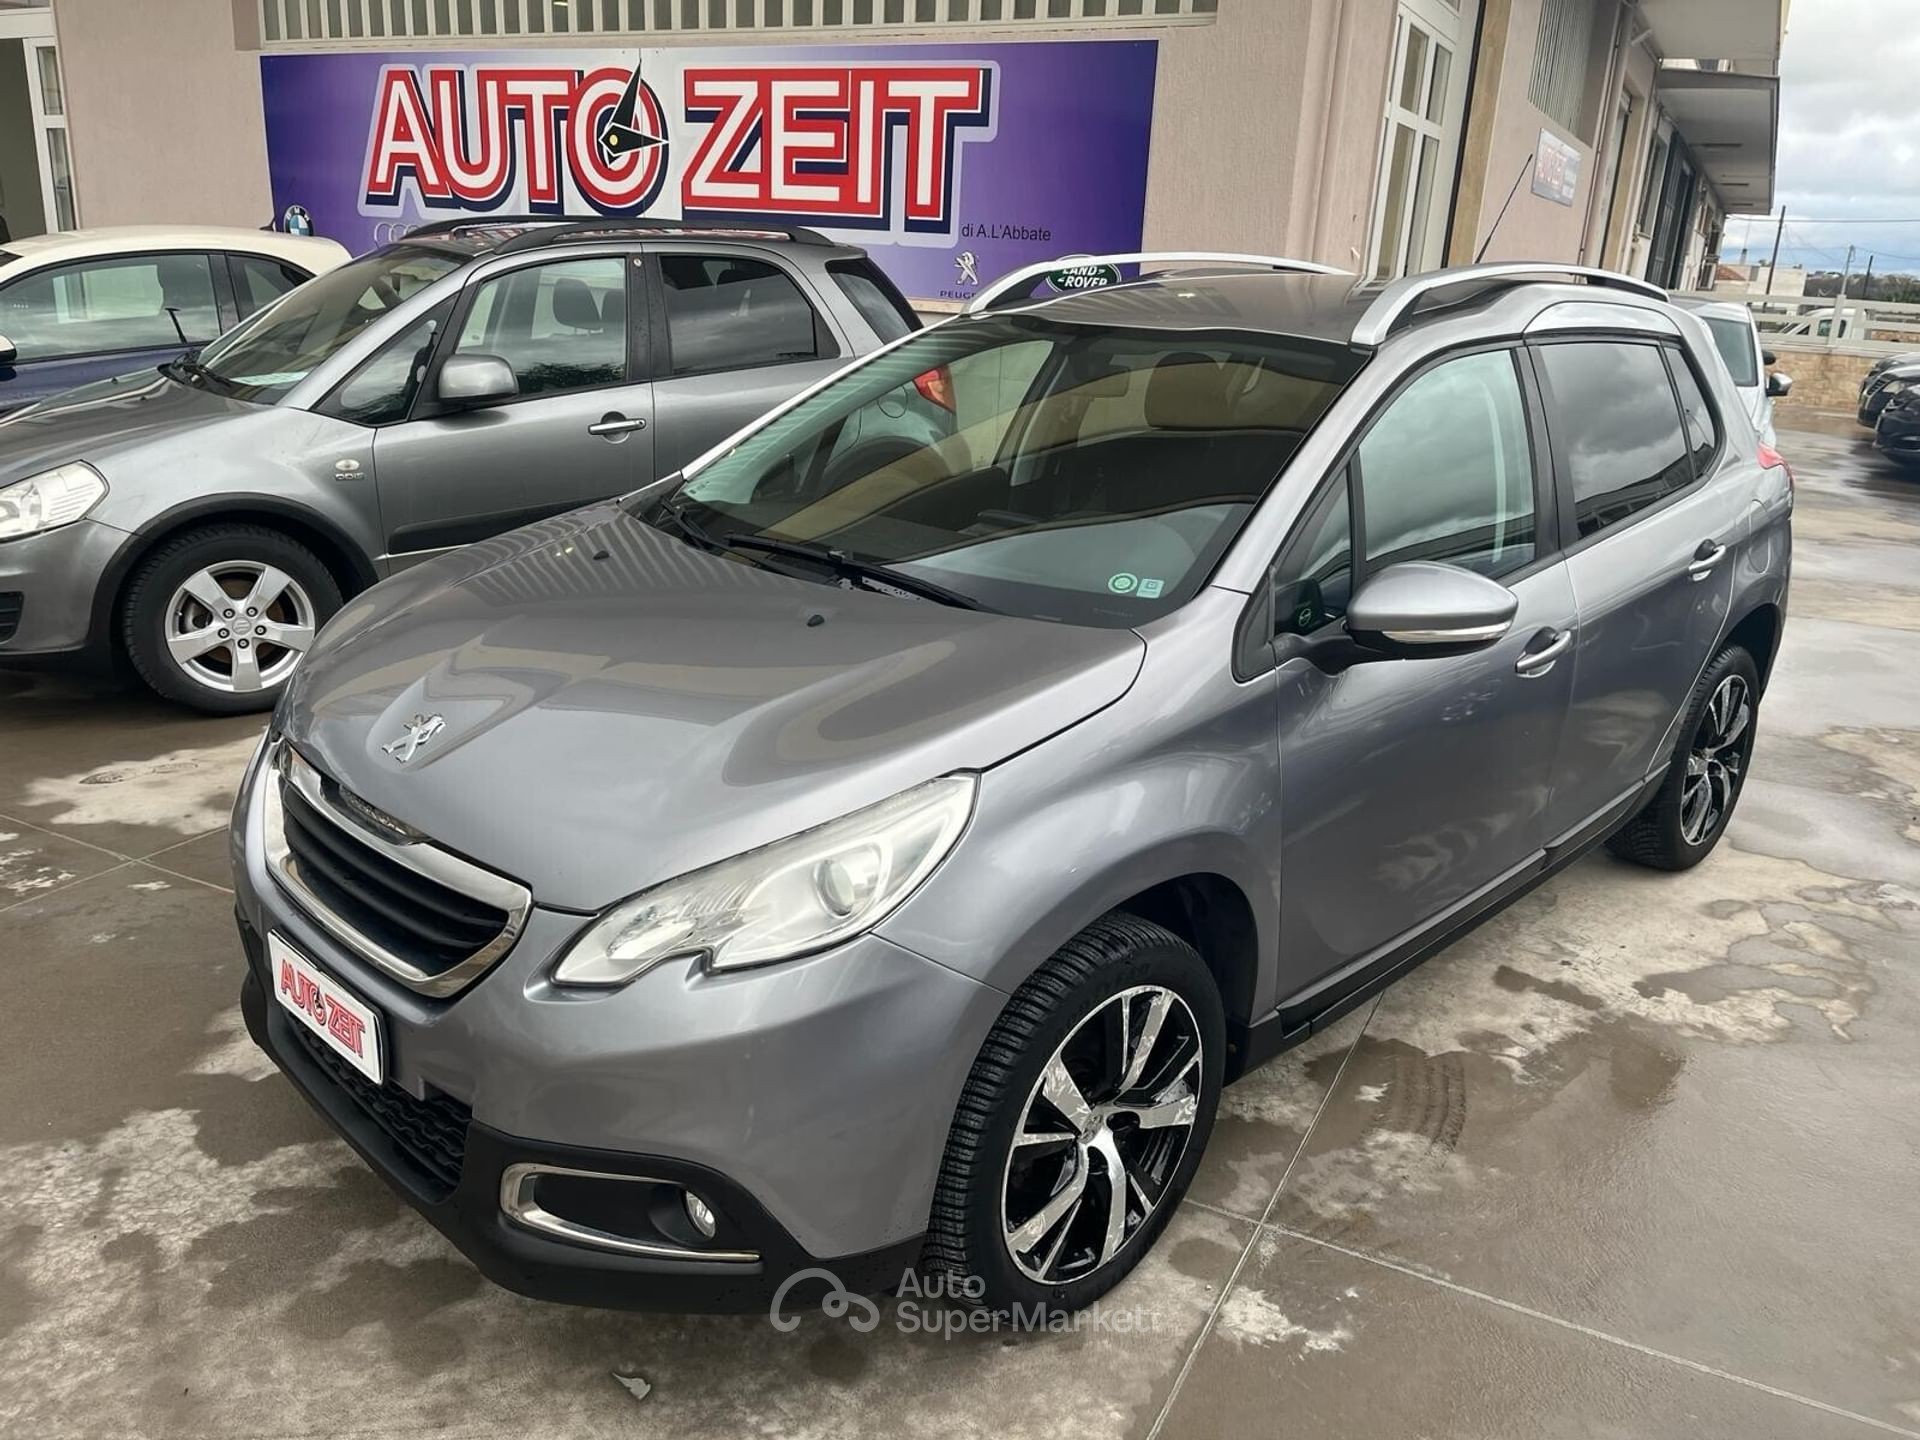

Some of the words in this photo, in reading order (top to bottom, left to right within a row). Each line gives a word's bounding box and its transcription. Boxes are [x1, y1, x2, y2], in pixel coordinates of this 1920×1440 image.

[366, 67, 669, 217] AUTO
[682, 68, 992, 233] ZEIT
[961, 223, 974, 238] di
[280, 958, 327, 1026] AUTO
[325, 993, 366, 1059] ZEIT
